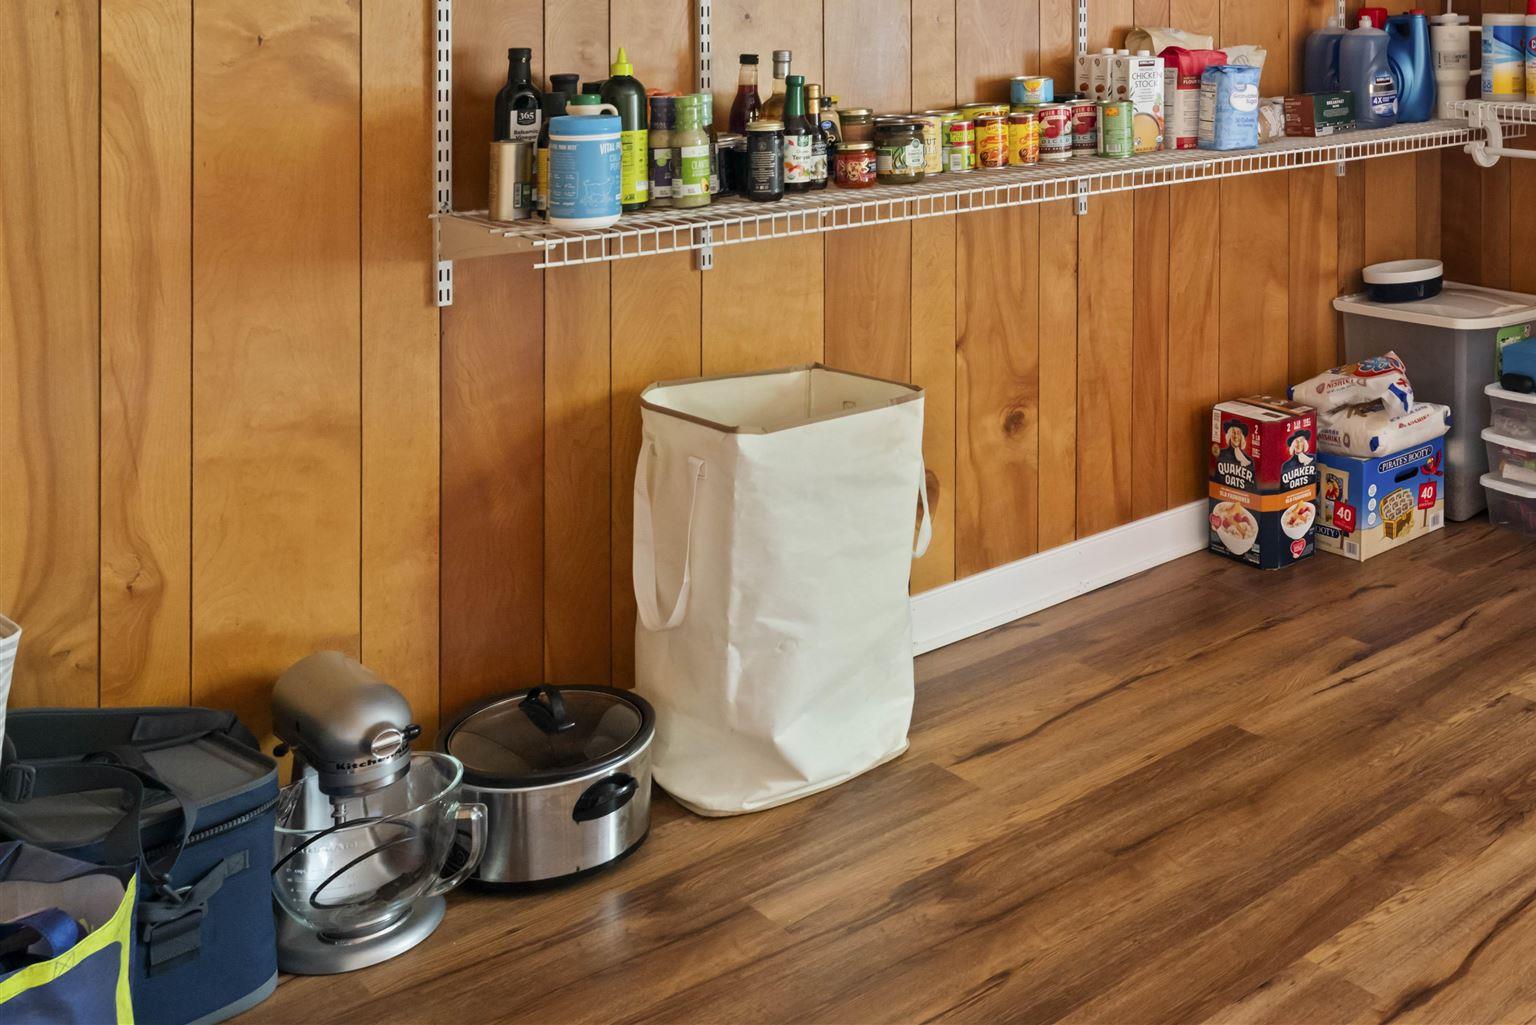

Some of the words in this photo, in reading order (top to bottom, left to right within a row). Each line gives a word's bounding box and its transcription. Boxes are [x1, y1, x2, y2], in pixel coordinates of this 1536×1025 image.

[1135, 80, 1158, 88] STOCK
[519, 112, 535, 121] 365
[600, 143, 615, 155] VITAL
[1254, 425, 1259, 434] 2
[1286, 422, 1291, 432] 2
[1382, 455, 1408, 471] PIRATE'S
[1408, 447, 1431, 463] BOOTY
[1218, 462, 1253, 482] QUAKER
[1282, 465, 1315, 483] QUAKER
[1225, 475, 1245, 489] OATS
[1289, 475, 1309, 489] OATS
[1421, 486, 1433, 500] 40
[1336, 506, 1352, 522] 40
[1317, 525, 1335, 536] OOTY
